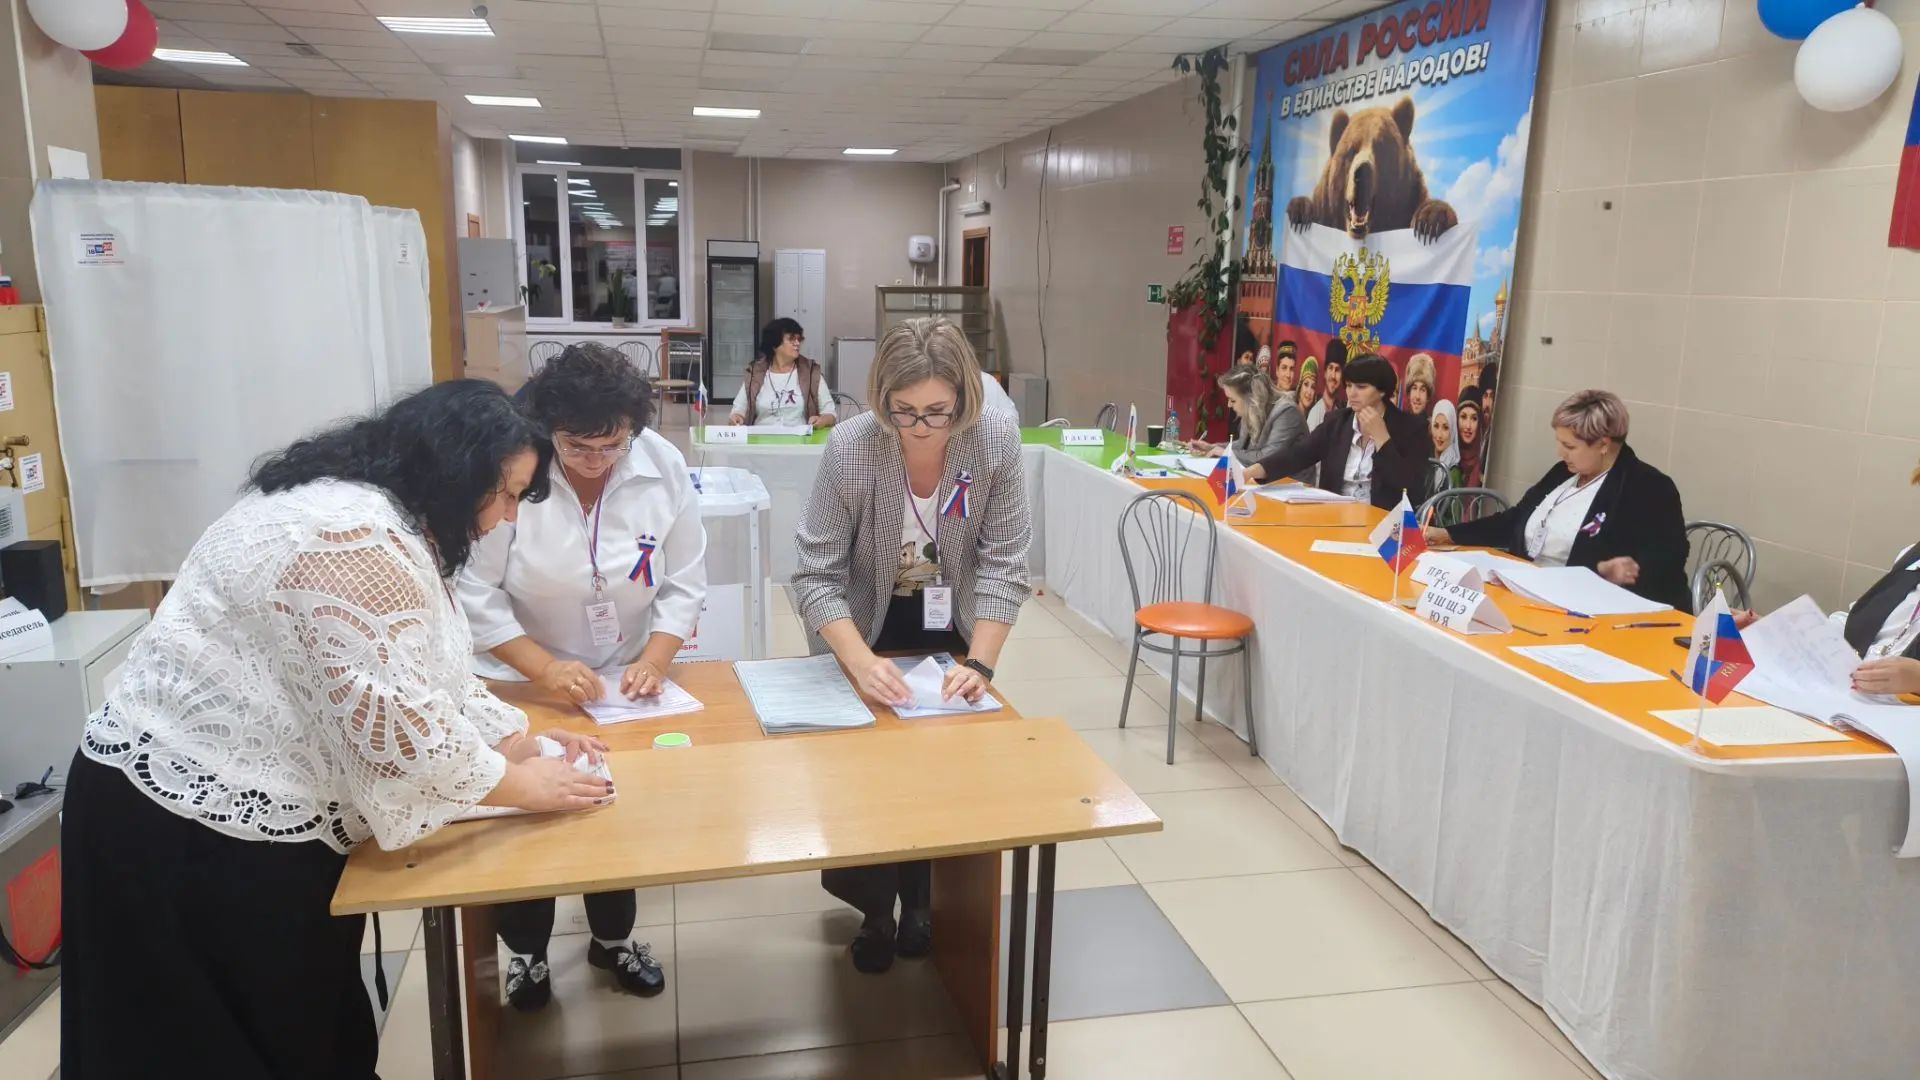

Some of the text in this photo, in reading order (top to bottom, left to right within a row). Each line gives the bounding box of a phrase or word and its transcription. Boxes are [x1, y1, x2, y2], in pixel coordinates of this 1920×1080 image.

[1280, 42, 1490, 119] В ЕДИНСТВЕ НАРОДОВ!
[1283, 0, 1491, 87] СИЛА РОССИИ
